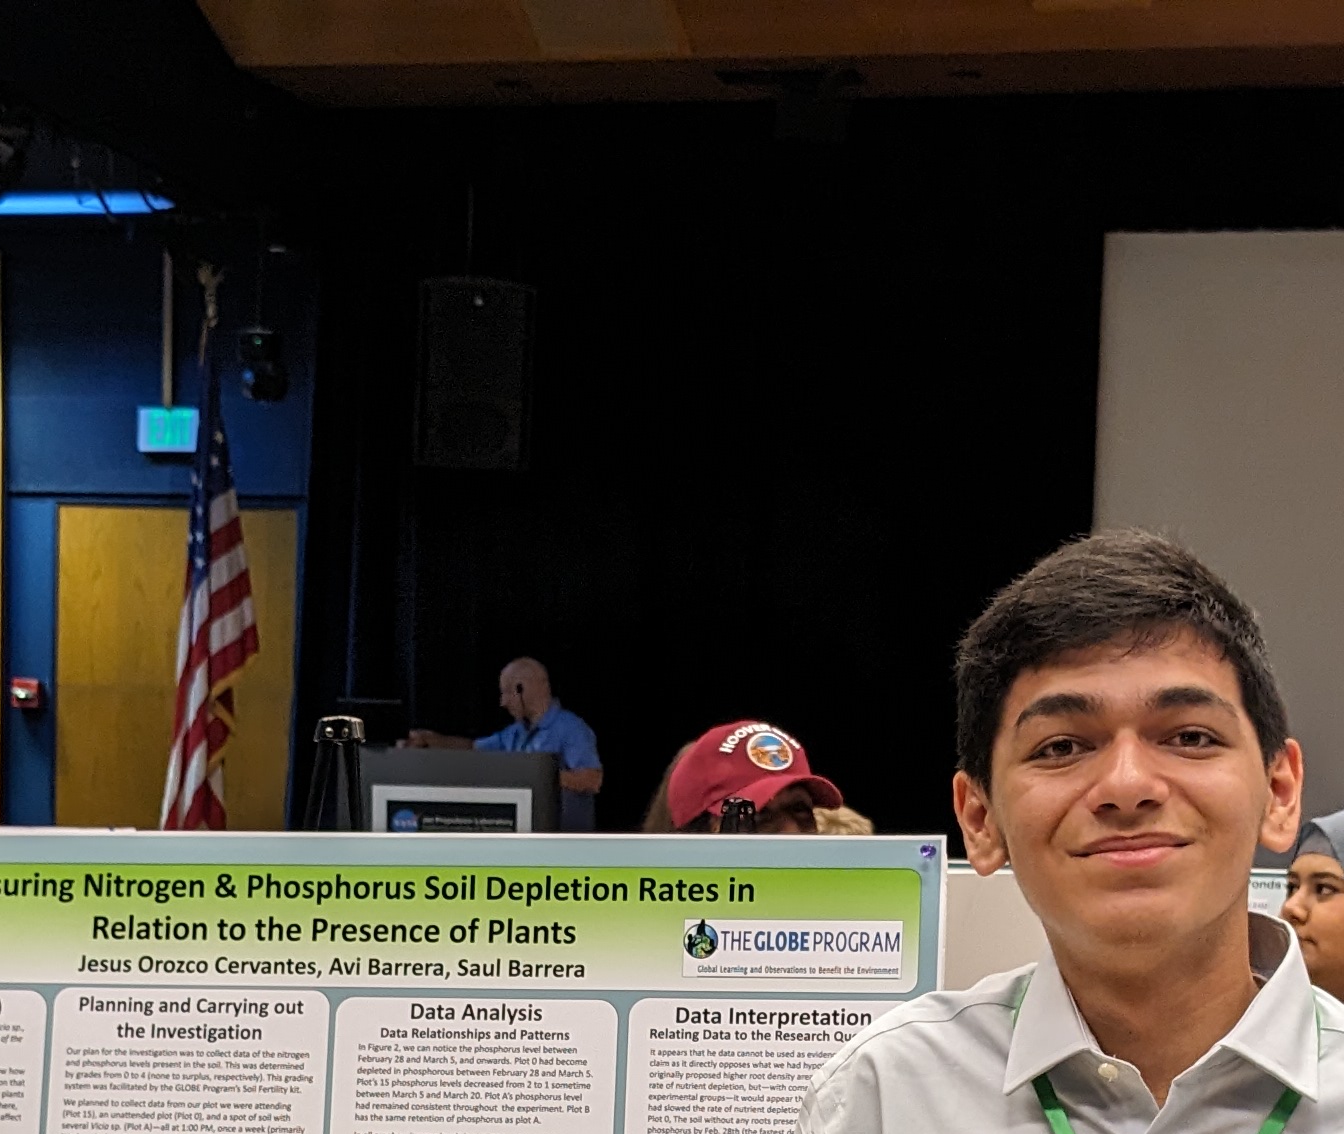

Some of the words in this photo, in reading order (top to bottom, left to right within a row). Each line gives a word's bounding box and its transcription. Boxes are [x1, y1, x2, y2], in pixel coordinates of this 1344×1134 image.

[719, 723, 771, 754] HOOVER
[84, 872, 204, 903] Nitrogen
[214, 873, 237, 898] &
[247, 872, 415, 905] Phosphorus
[424, 874, 475, 900] Soil
[486, 874, 627, 907] Depletion
[639, 877, 718, 902] Rates
[729, 876, 754, 902] in
[92, 914, 207, 940] Relation
[216, 918, 245, 941] to
[254, 915, 301, 941] the
[311, 918, 439, 942] Presence
[449, 917, 480, 943] of
[488, 917, 575, 944] Plants
[720, 930, 752, 951] THE
[753, 930, 809, 951] GLOBE
[812, 931, 900, 952] PROGRAM
[78, 954, 131, 972] Jesus
[138, 955, 208, 973] Orozco
[214, 956, 322, 978] Cervantes,
[328, 957, 360, 975] Avi
[368, 958, 450, 979] Barrera,
[457, 958, 500, 977] Saul
[508, 959, 584, 977] Barrera
[697, 964, 717, 973] Global
[719, 965, 748, 975] Learning
[749, 965, 762, 973] and
[764, 965, 807, 974] Observations
[808, 966, 816, 974] to
[818, 965, 841, 974] Benefit
[843, 966, 854, 974] the
[856, 966, 898, 974] Environment
[79, 995, 154, 1016] Planning
[158, 997, 190, 1013] and
[196, 998, 269, 1018] Carrying
[273, 1000, 303, 1014] out
[410, 1003, 455, 1020] Data
[461, 1003, 542, 1025] Analysis
[675, 1006, 721, 1024] Data
[729, 1007, 871, 1029] Interpretation
[116, 1022, 145, 1038] the
[151, 1023, 261, 1043] Investigation
[380, 1027, 407, 1038] Data
[411, 1027, 491, 1041] Relationships
[493, 1028, 516, 1040] and
[520, 1029, 569, 1040] Patterns
[649, 1027, 699, 1042] Relating
[702, 1029, 731, 1040] Data
[734, 1030, 747, 1040] to
[751, 1029, 771, 1040] the
[775, 1027, 830, 1041] Research
[833, 1030, 856, 1043] Qu
[66, 1046, 81, 1055] Our
[82, 1047, 100, 1056] plan
[101, 1047, 112, 1055] for
[113, 1048, 127, 1056] the
[129, 1048, 177, 1058] investigation
[205, 1049, 231, 1057] collect
[232, 1049, 250, 1058] data
[251, 1049, 261, 1058] of
[261, 1050, 275, 1058] the
[276, 1051, 310, 1060] nitrogen
[367, 1042, 392, 1052] Figure
[393, 1043, 401, 1052] 2,
[458, 1044, 472, 1052] the
[473, 1044, 520, 1054] phosphorus
[522, 1045, 541, 1053] level
[542, 1045, 577, 1054] between
